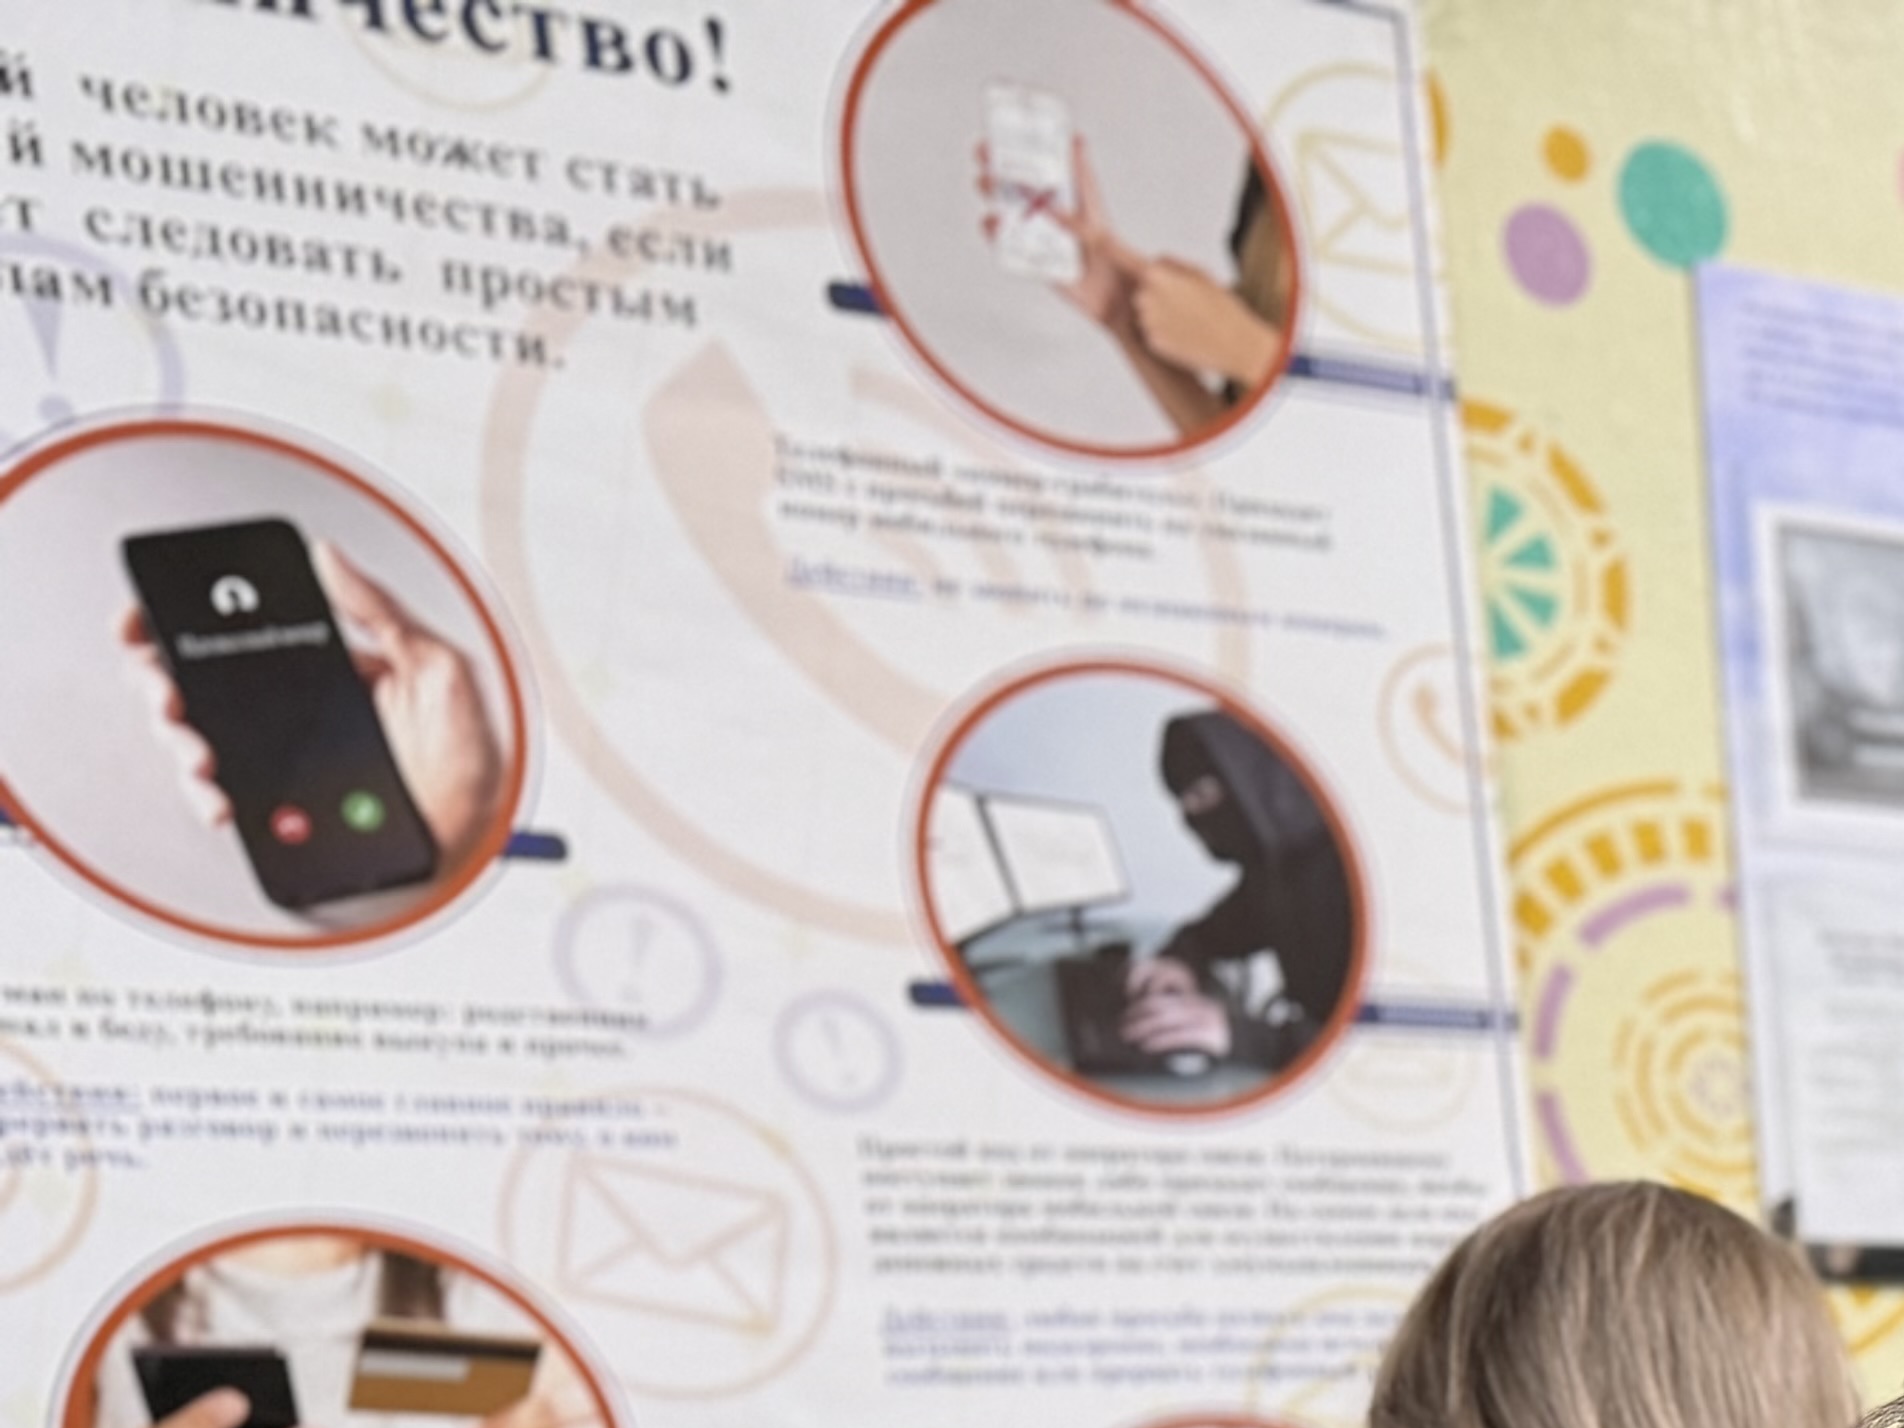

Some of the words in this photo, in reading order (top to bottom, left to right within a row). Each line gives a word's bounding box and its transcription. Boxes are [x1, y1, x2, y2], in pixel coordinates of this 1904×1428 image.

[198, 0, 730, 94] чество!
[78, 73, 340, 149] человек
[360, 122, 541, 182] может
[564, 156, 721, 210] стать
[70, 140, 590, 258] мошенничества,
[606, 224, 733, 272] если
[84, 206, 402, 284] следовать
[440, 258, 697, 328] простым
[137, 266, 566, 369] безопасности.
